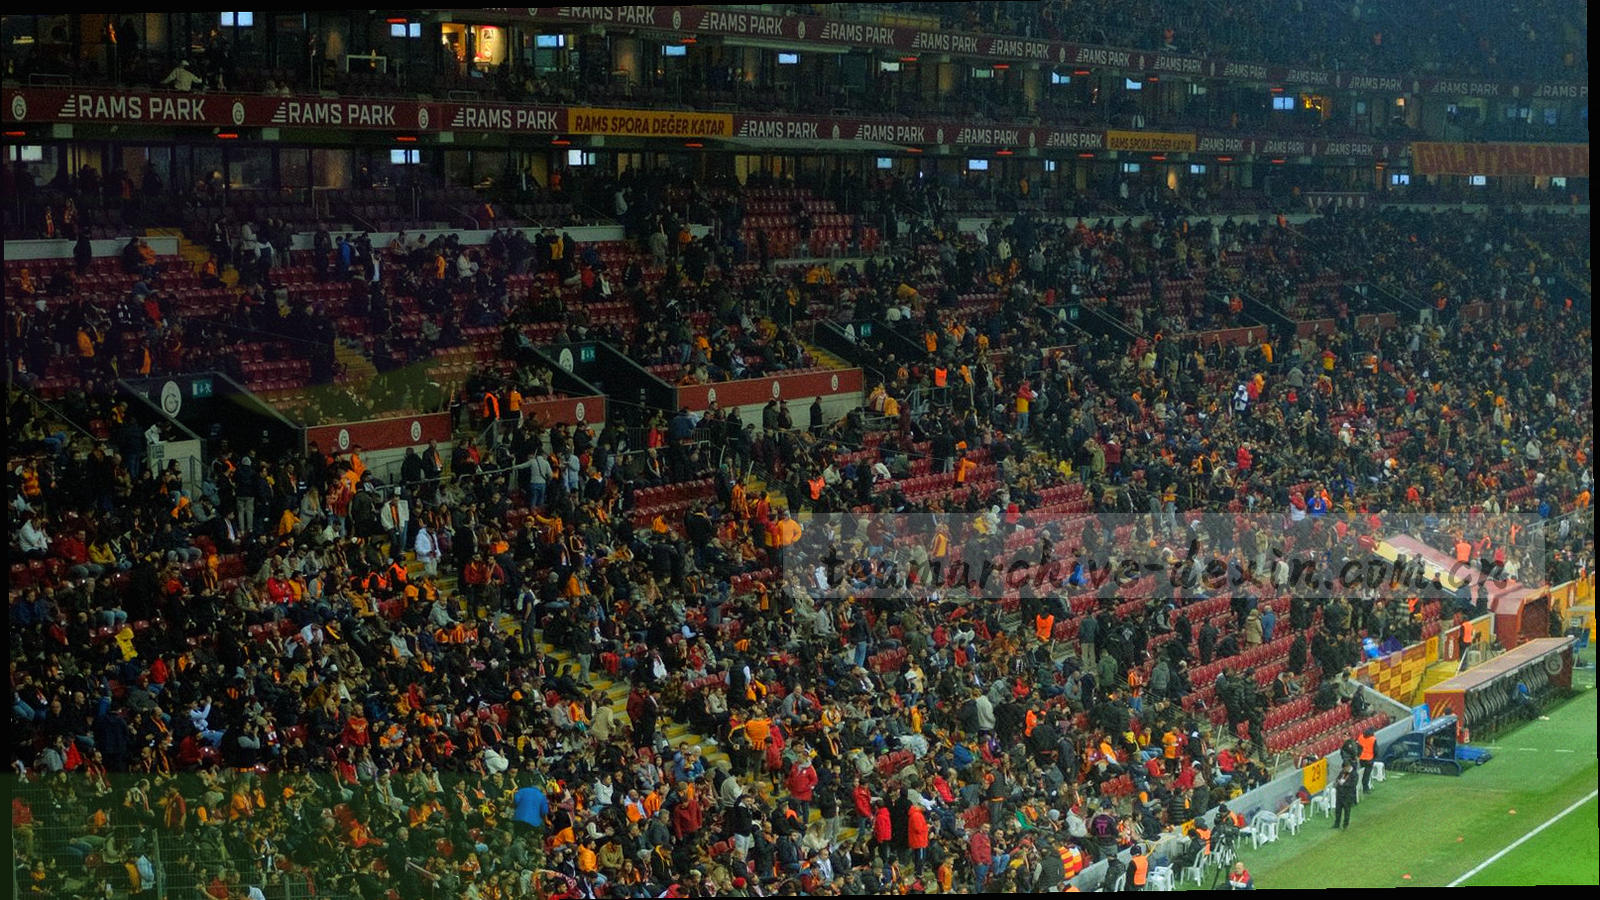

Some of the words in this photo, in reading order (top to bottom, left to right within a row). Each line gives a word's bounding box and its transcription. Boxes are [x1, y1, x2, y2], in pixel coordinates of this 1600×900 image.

[710, 13, 747, 33] RAMS
[750, 16, 783, 35] PARK
[831, 23, 863, 41] RAMS
[866, 26, 895, 45] PARK
[920, 32, 949, 50] RAMS
[952, 36, 978, 52] PARK
[997, 39, 1023, 57] RAMS
[1025, 42, 1049, 59] PARK
[1083, 49, 1106, 65] RAMS
[1108, 51, 1130, 66] PARK
[1160, 56, 1182, 72] RAMS
[1183, 58, 1202, 73] PARK
[1354, 76, 1378, 89] RAMS
[1380, 79, 1402, 91] PARK
[1440, 81, 1468, 95] RAMS
[1469, 83, 1499, 96] PARK
[1543, 85, 1577, 97] RAMS
[79, 95, 142, 119] RAMS
[150, 98, 206, 121] PARK
[288, 103, 342, 124] RAMS
[349, 105, 396, 125] PARK
[466, 108, 511, 128] RAMS
[517, 110, 558, 130] PARK
[575, 115, 608, 132] RAMS
[611, 116, 649, 134] SPORA
[652, 114, 689, 135] DEĞER
[690, 118, 725, 135] KATAR
[749, 120, 783, 138] RAMS
[787, 121, 818, 139] PARK
[863, 125, 893, 141] RAMS
[897, 126, 925, 142] PARK
[964, 128, 992, 144] RAMS
[994, 129, 1019, 145] PARK
[1053, 132, 1078, 147] RAMS
[1080, 133, 1102, 148] PARK
[1204, 137, 1224, 151] RAMS
[1225, 139, 1243, 151] PARK
[1311, 764, 1322, 782] 29
